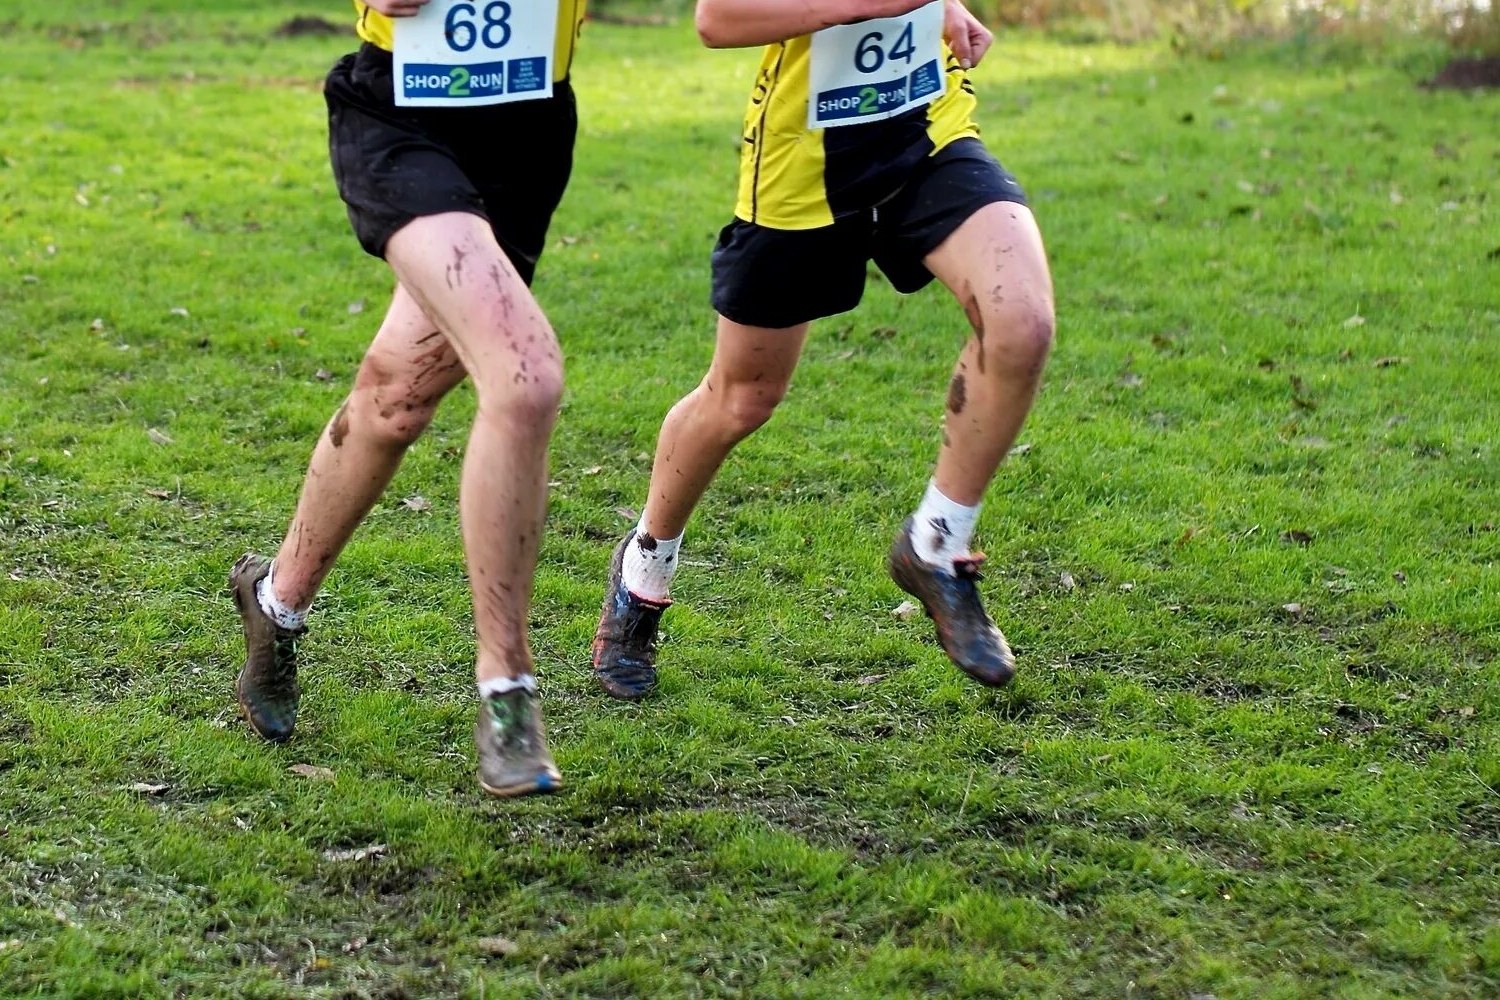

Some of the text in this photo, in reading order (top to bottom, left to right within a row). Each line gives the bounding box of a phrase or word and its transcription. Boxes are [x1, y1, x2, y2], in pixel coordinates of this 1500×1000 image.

[444, 0, 512, 53] 68
[854, 21, 916, 74] 64
[405, 66, 502, 96] SHOP2RUN
